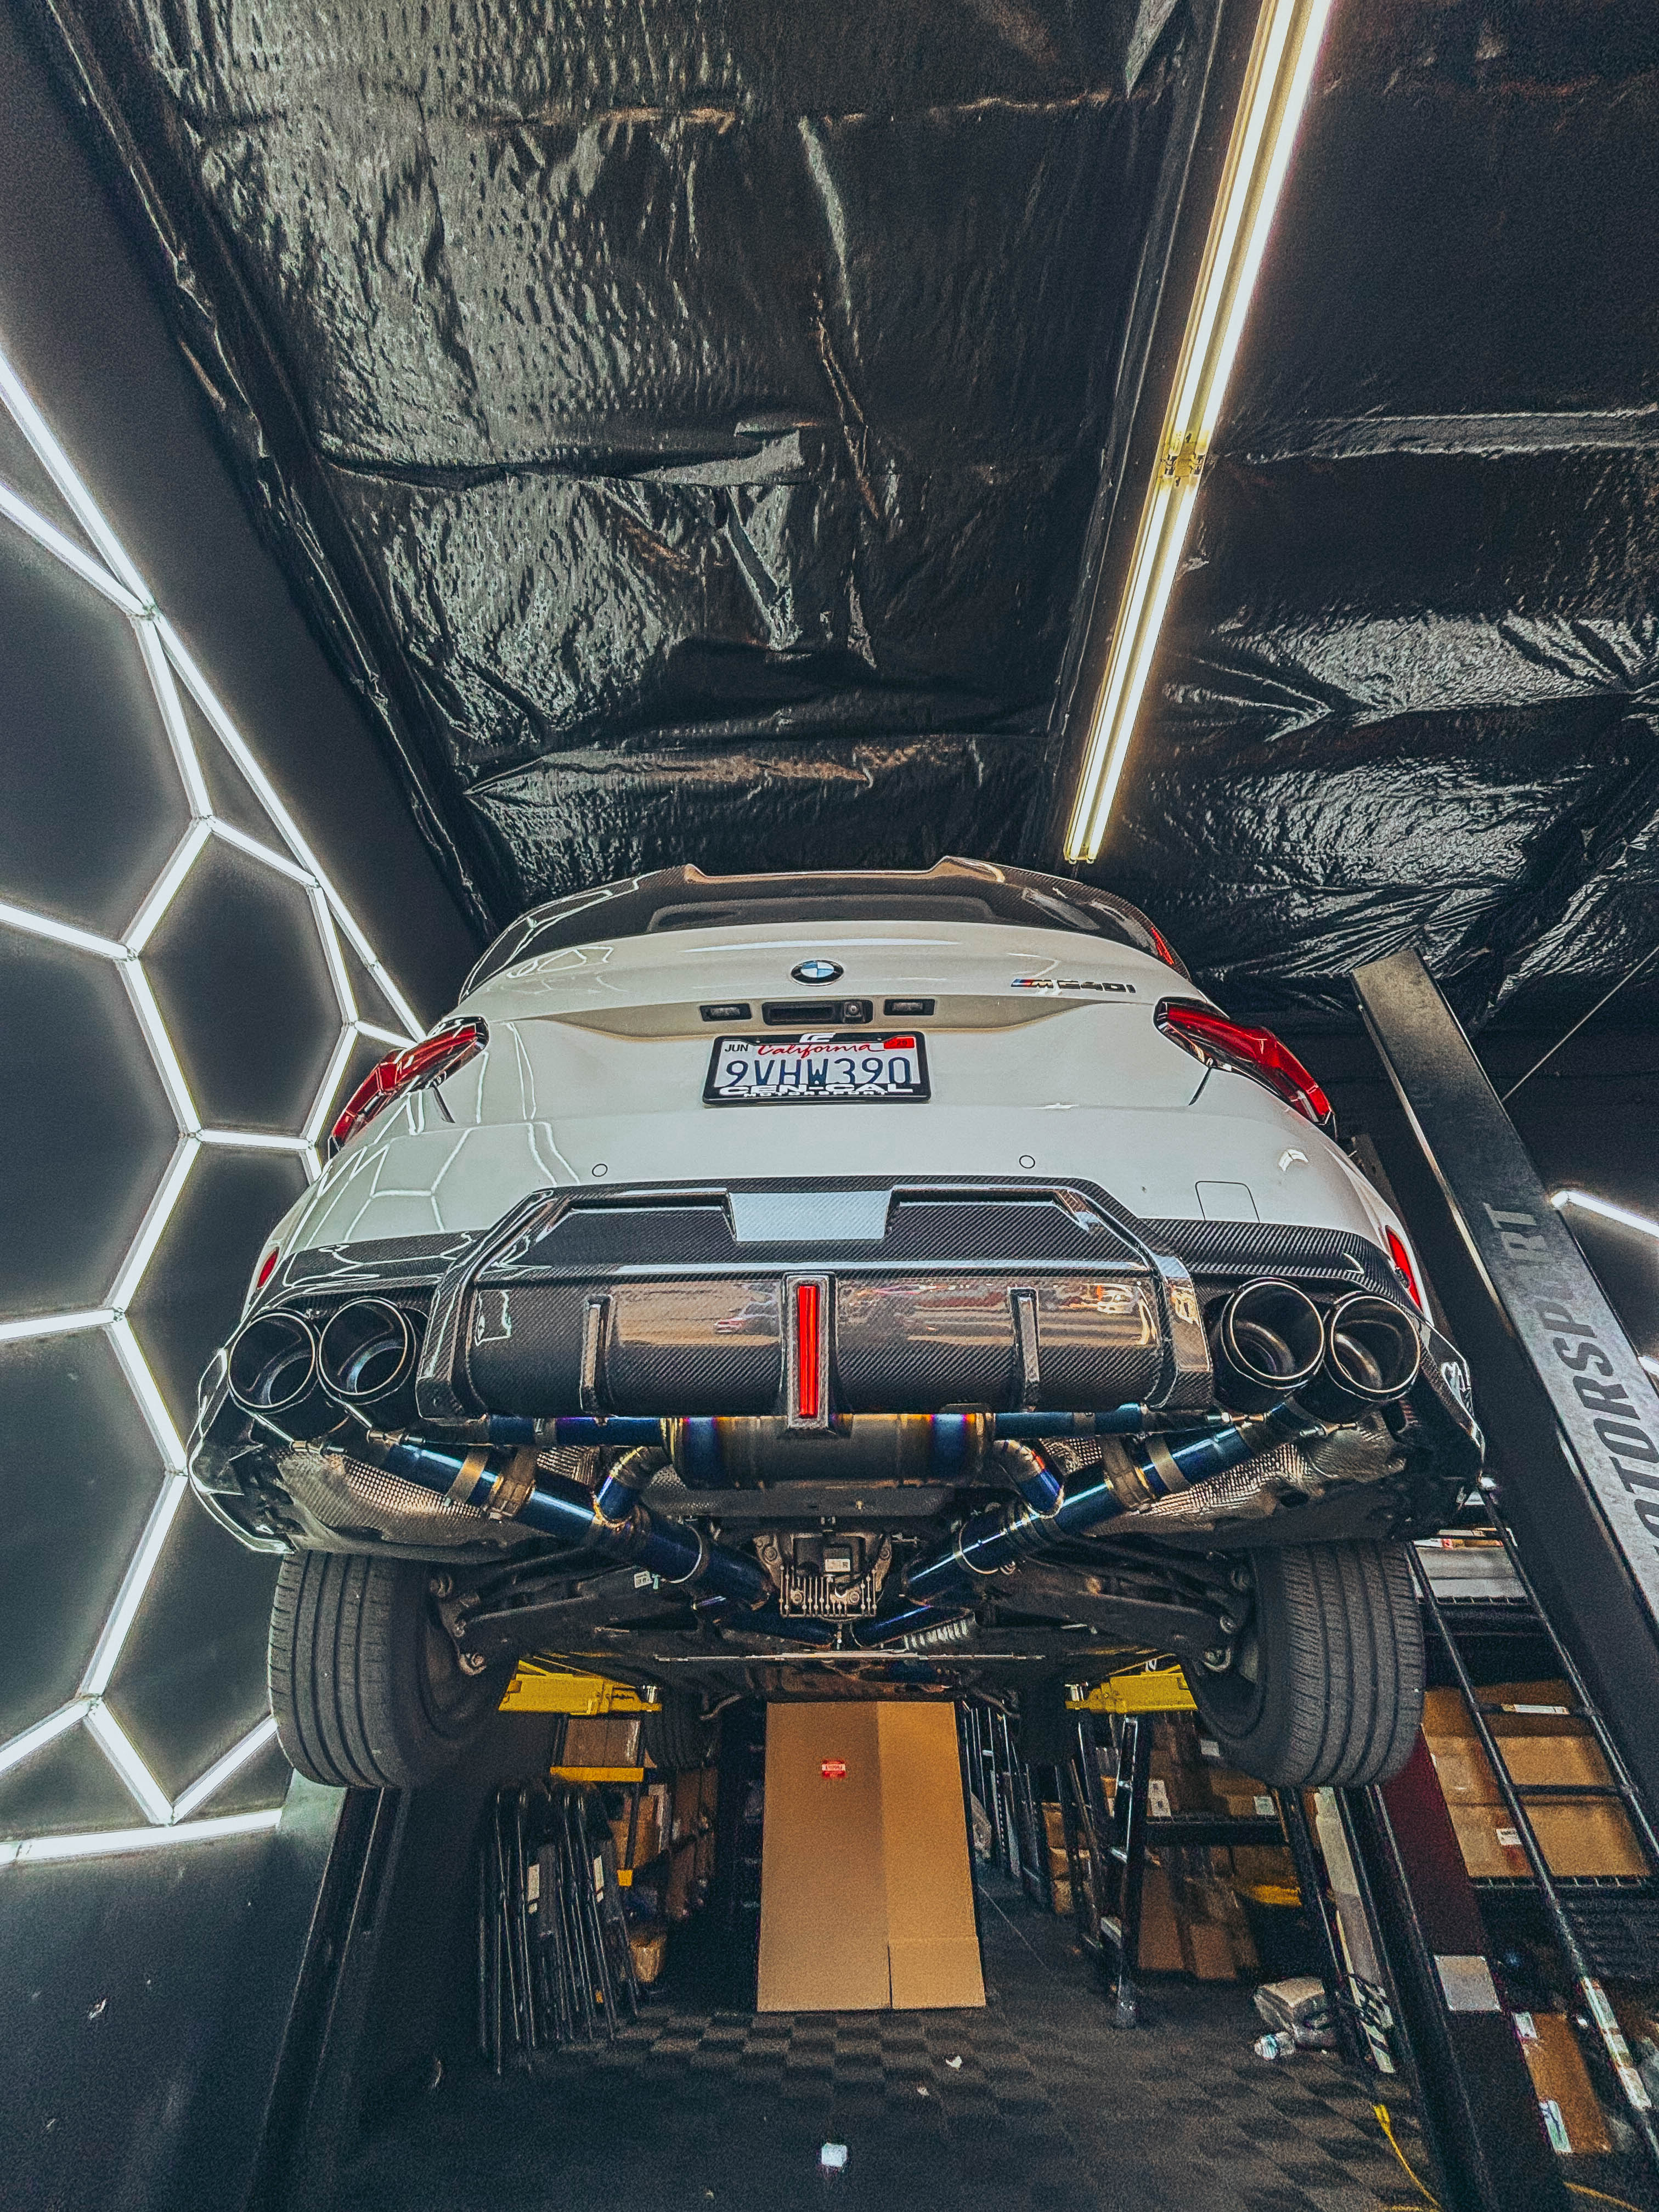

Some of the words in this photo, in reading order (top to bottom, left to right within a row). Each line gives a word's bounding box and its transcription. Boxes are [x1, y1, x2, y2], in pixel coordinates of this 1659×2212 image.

[725, 1044, 749, 1052] JUN
[757, 1045, 884, 1058] California
[726, 1057, 911, 1086] 9VHW390
[719, 1084, 913, 1097] CEN-CAL
